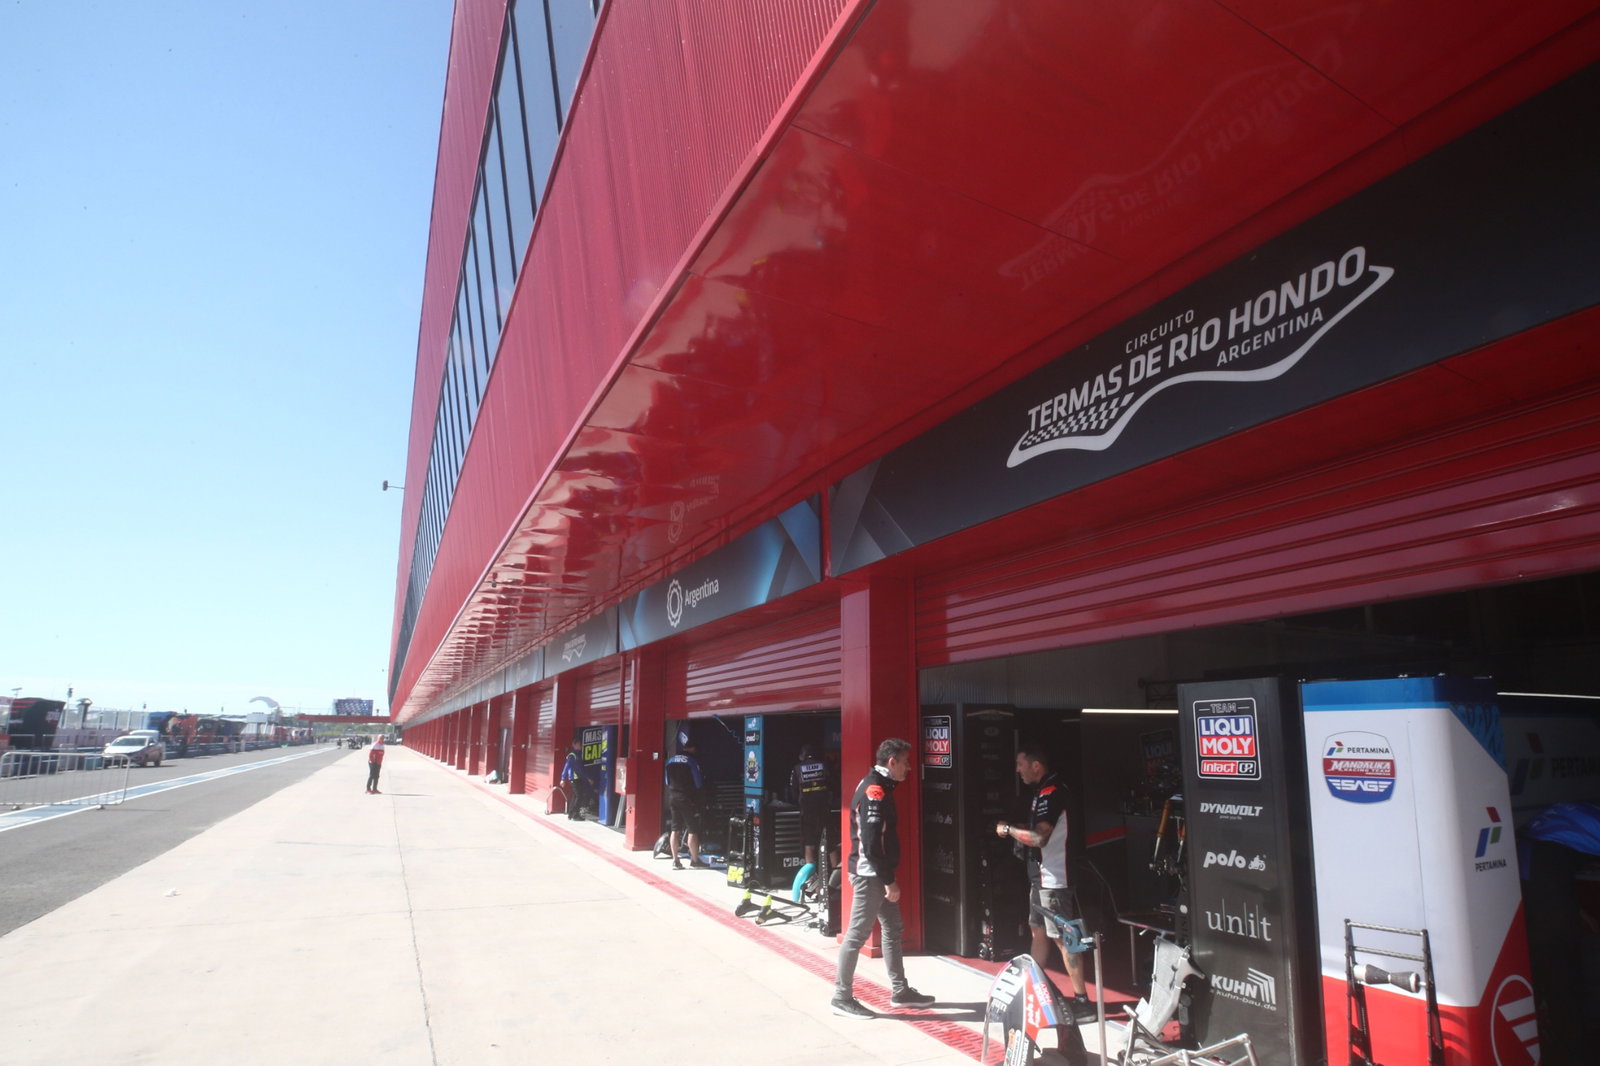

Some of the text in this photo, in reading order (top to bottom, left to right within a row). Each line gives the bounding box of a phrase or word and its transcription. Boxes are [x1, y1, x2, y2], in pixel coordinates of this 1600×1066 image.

[1028, 364, 1122, 431] TERMAS
[1128, 345, 1162, 387] DE
[1227, 246, 1366, 340] HONDO
[1125, 309, 1194, 354] CIRCUITO
[1217, 307, 1324, 367] ARGENTINA
[685, 578, 720, 608] Argentina
[1210, 703, 1237, 713] TEAM
[1201, 718, 1251, 736] LIQUI
[1202, 738, 1252, 755] MOLY
[1200, 803, 1263, 816] DYNAVOLT
[1203, 850, 1246, 868] polo
[1205, 911, 1272, 941] unit
[1211, 974, 1258, 999] KUHN
[1216, 989, 1277, 1011] kuhn-bau.de
